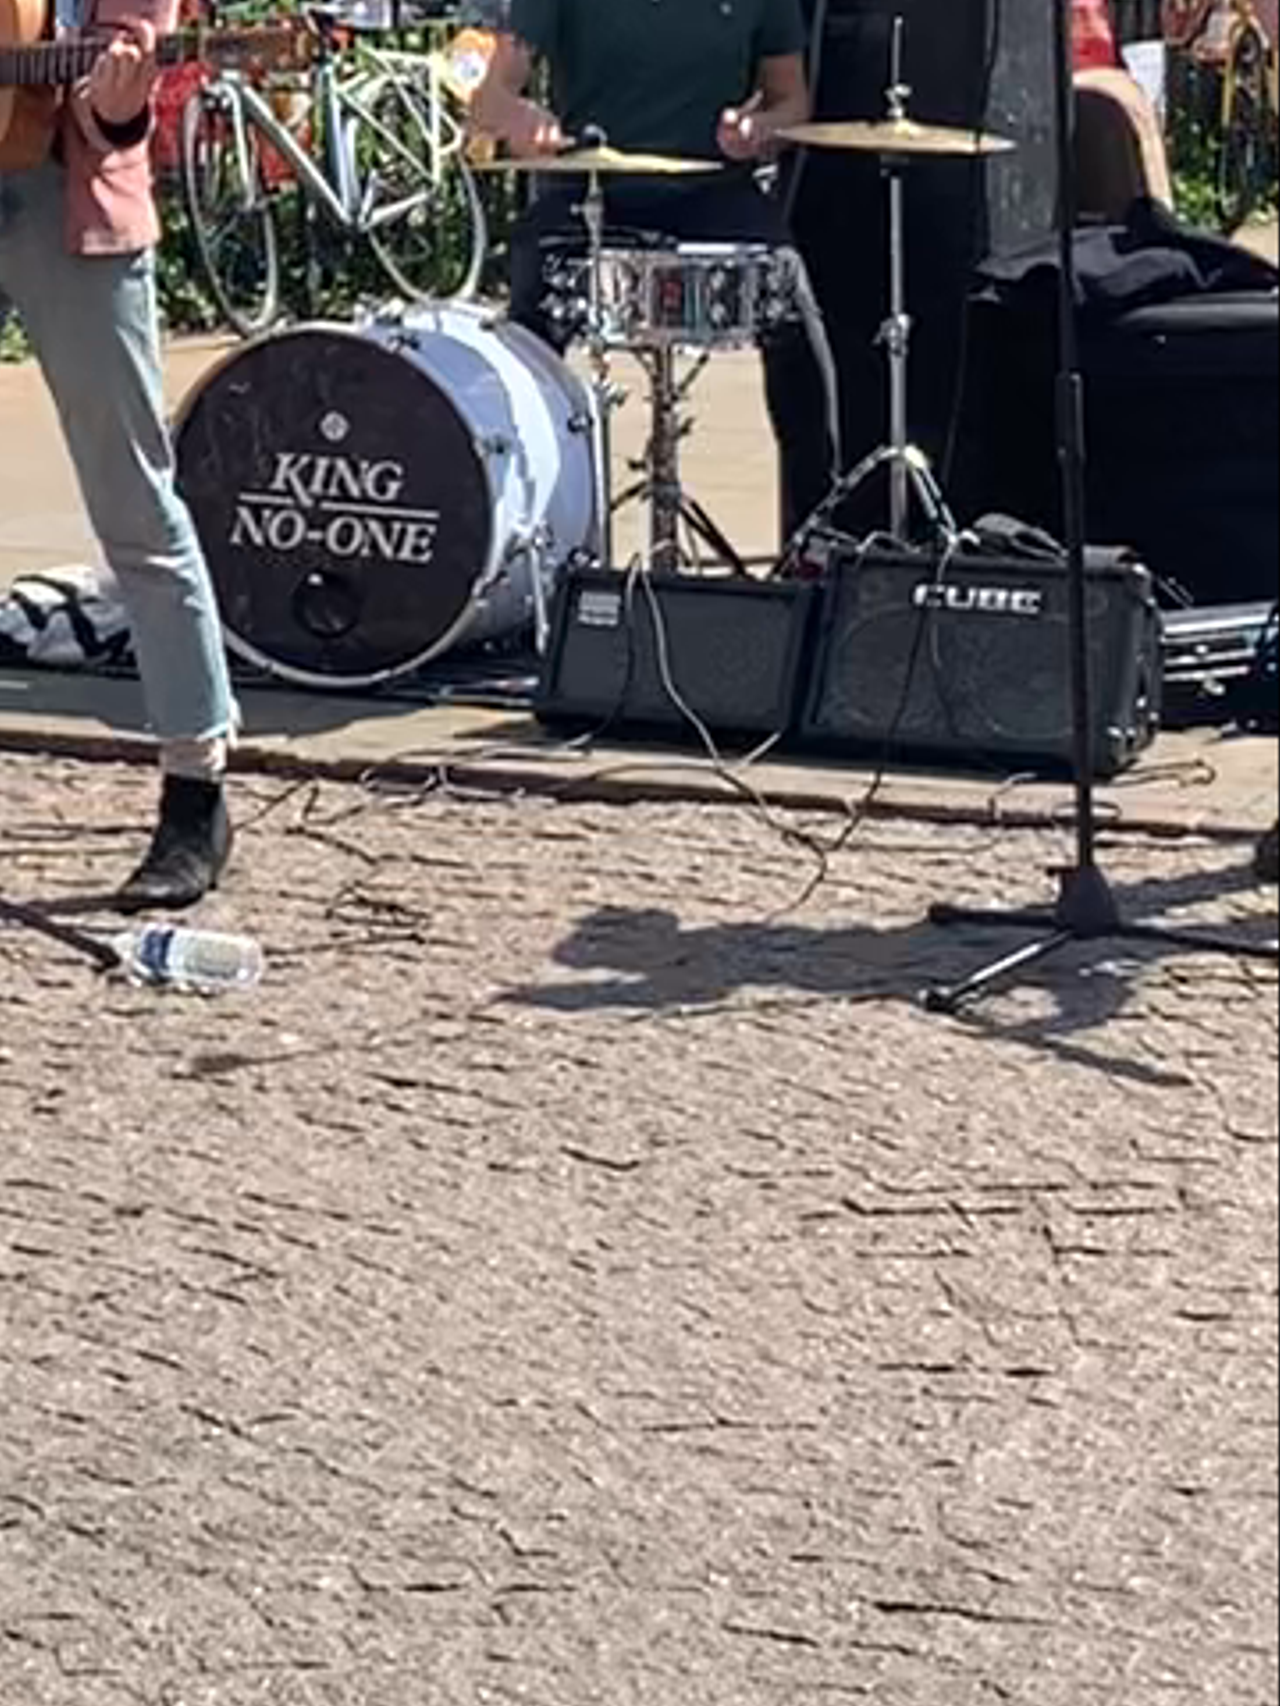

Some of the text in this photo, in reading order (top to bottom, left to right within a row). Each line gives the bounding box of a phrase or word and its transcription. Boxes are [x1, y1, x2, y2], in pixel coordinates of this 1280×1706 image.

[268, 452, 405, 507] KING
[229, 505, 439, 564] NO-ONE
[913, 583, 1041, 615] CUBE
